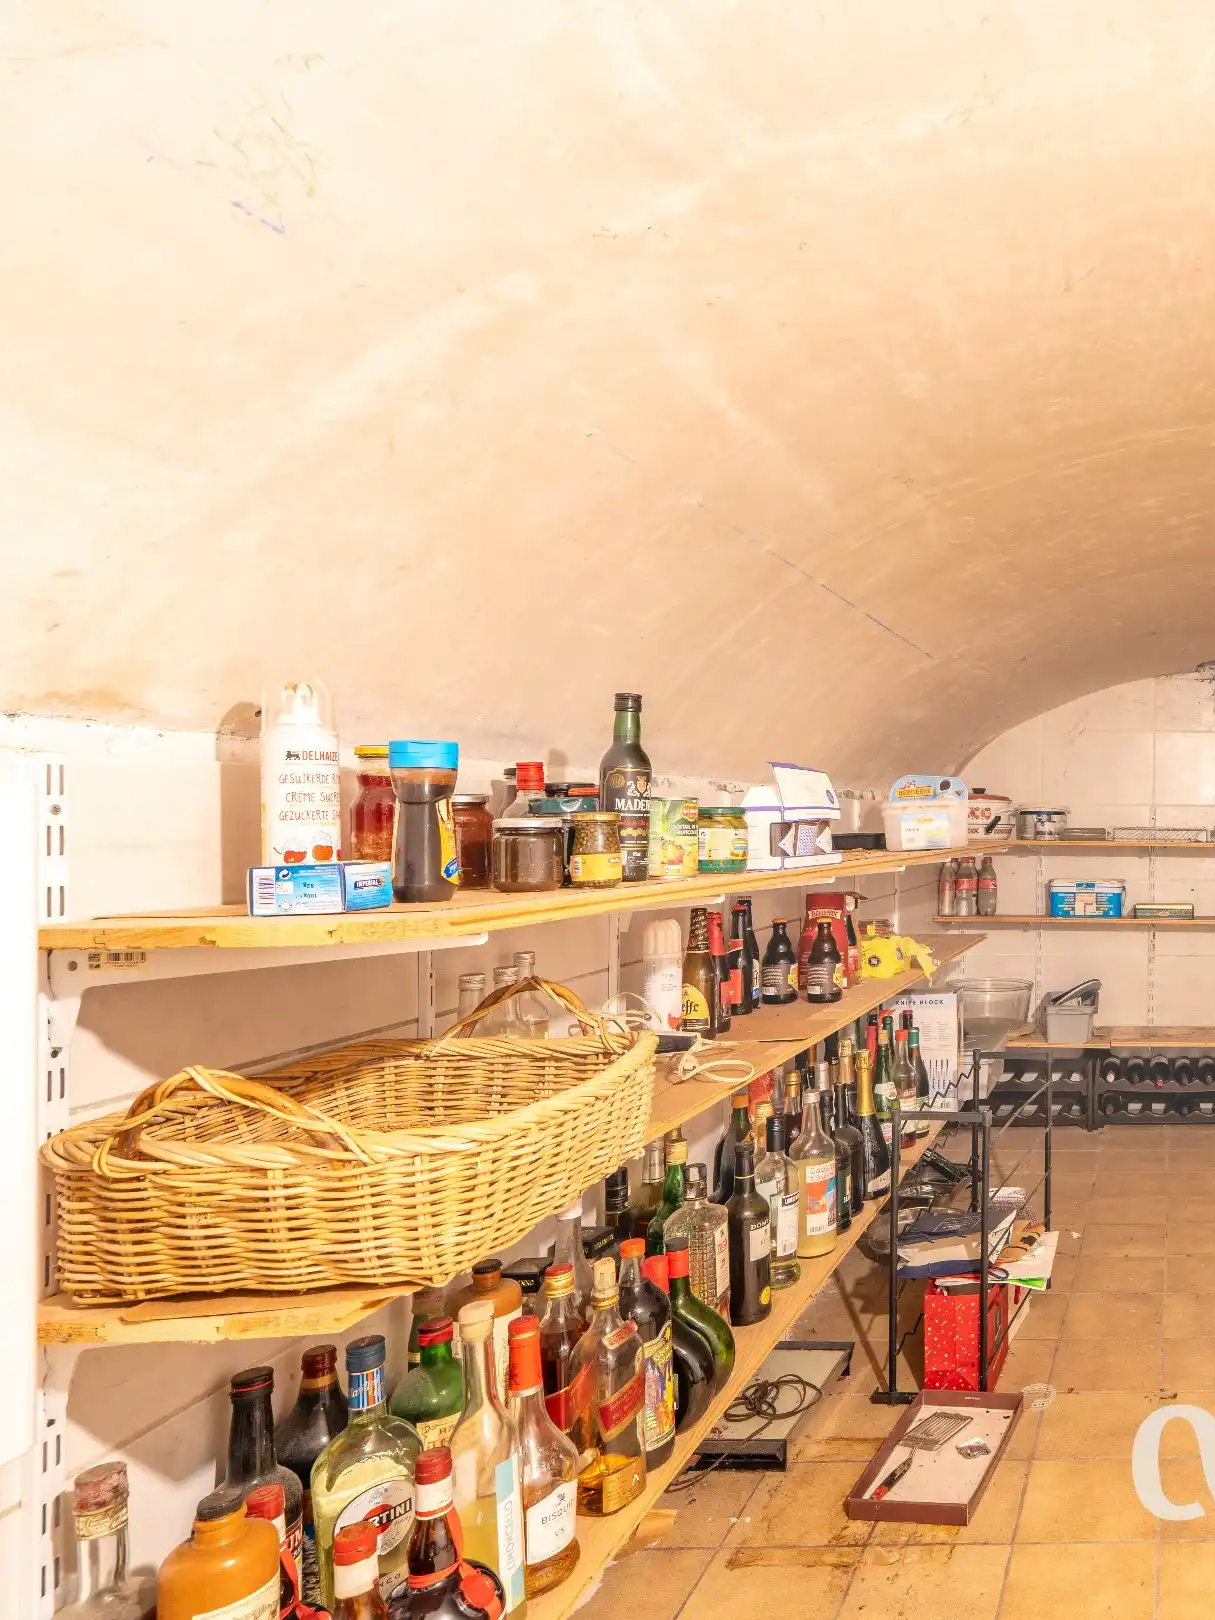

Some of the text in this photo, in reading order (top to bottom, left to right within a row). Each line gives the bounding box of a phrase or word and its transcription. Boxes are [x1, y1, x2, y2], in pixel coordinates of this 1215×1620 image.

[302, 750, 339, 762] DELHAIZE
[279, 810, 329, 822] GEZUCKERTE
[681, 999, 700, 1016] effe
[369, 1497, 413, 1528] RTINI
[378, 1572, 401, 1588] NCO
